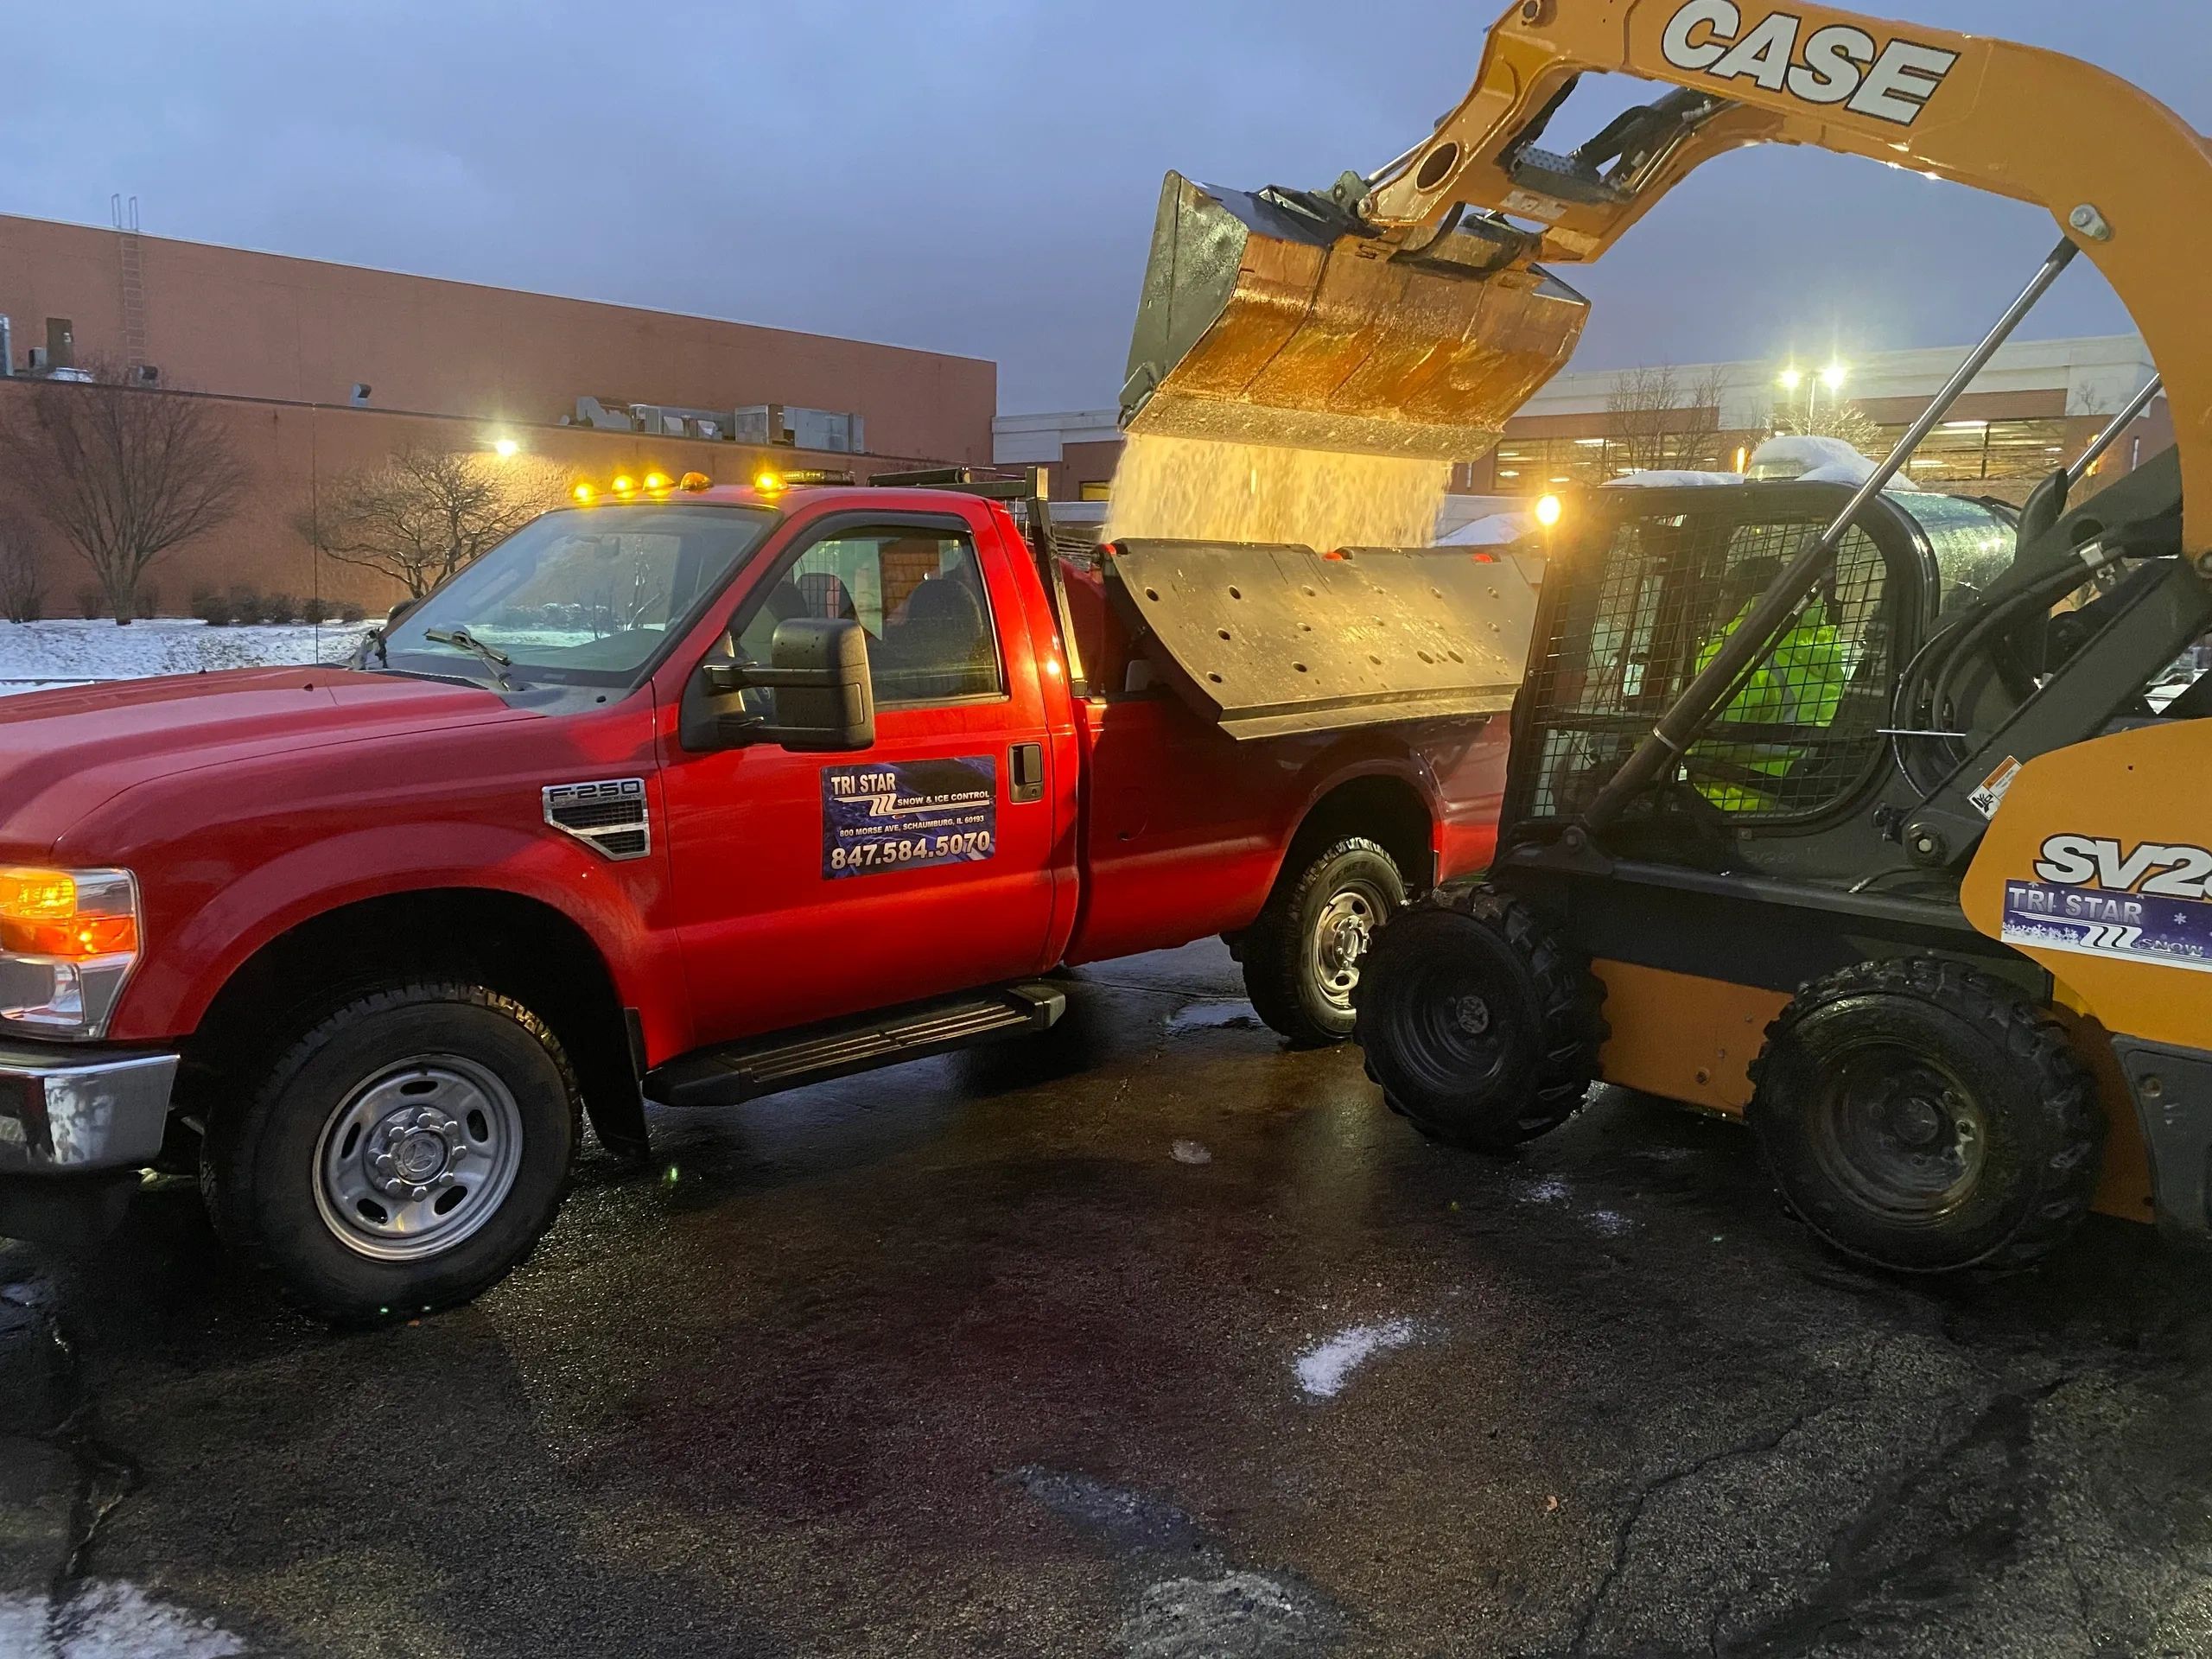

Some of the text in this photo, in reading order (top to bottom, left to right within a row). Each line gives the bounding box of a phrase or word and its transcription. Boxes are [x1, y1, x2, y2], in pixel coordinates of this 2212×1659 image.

[1661, 0, 1961, 126] CASE
[549, 780, 640, 803] F-250
[830, 772, 897, 795] TRI STAR
[897, 797, 924, 806] SNOW
[934, 794, 950, 803] ICE
[950, 790, 990, 801] CONTROL
[839, 829, 855, 837] 800
[855, 826, 883, 836] MORSE
[902, 817, 955, 830] SCHAUMBURG,
[964, 815, 984, 823] 60193
[830, 830, 991, 870] 847.584.5070
[2033, 832, 2212, 899] SV2
[2008, 887, 2143, 925] TRI STAR
[2139, 938, 2204, 957] SNOW
